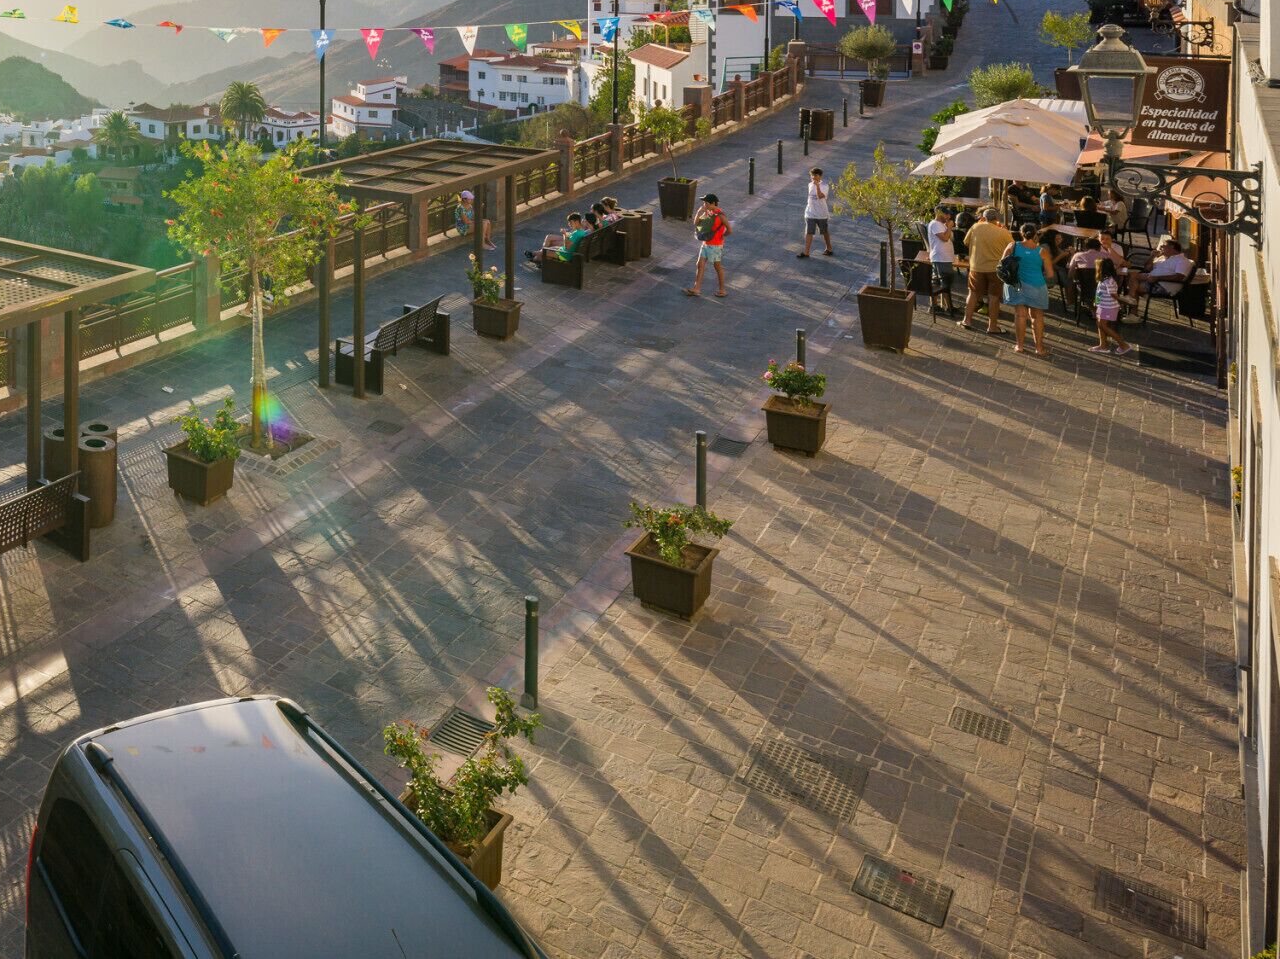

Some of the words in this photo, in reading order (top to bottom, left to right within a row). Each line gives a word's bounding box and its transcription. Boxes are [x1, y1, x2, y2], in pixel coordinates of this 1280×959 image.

[1140, 105, 1219, 120] Especialidad
[1141, 119, 1157, 128] en
[1158, 118, 1198, 131] Dulces
[1199, 121, 1216, 132] de
[1147, 129, 1208, 143] Almendra
